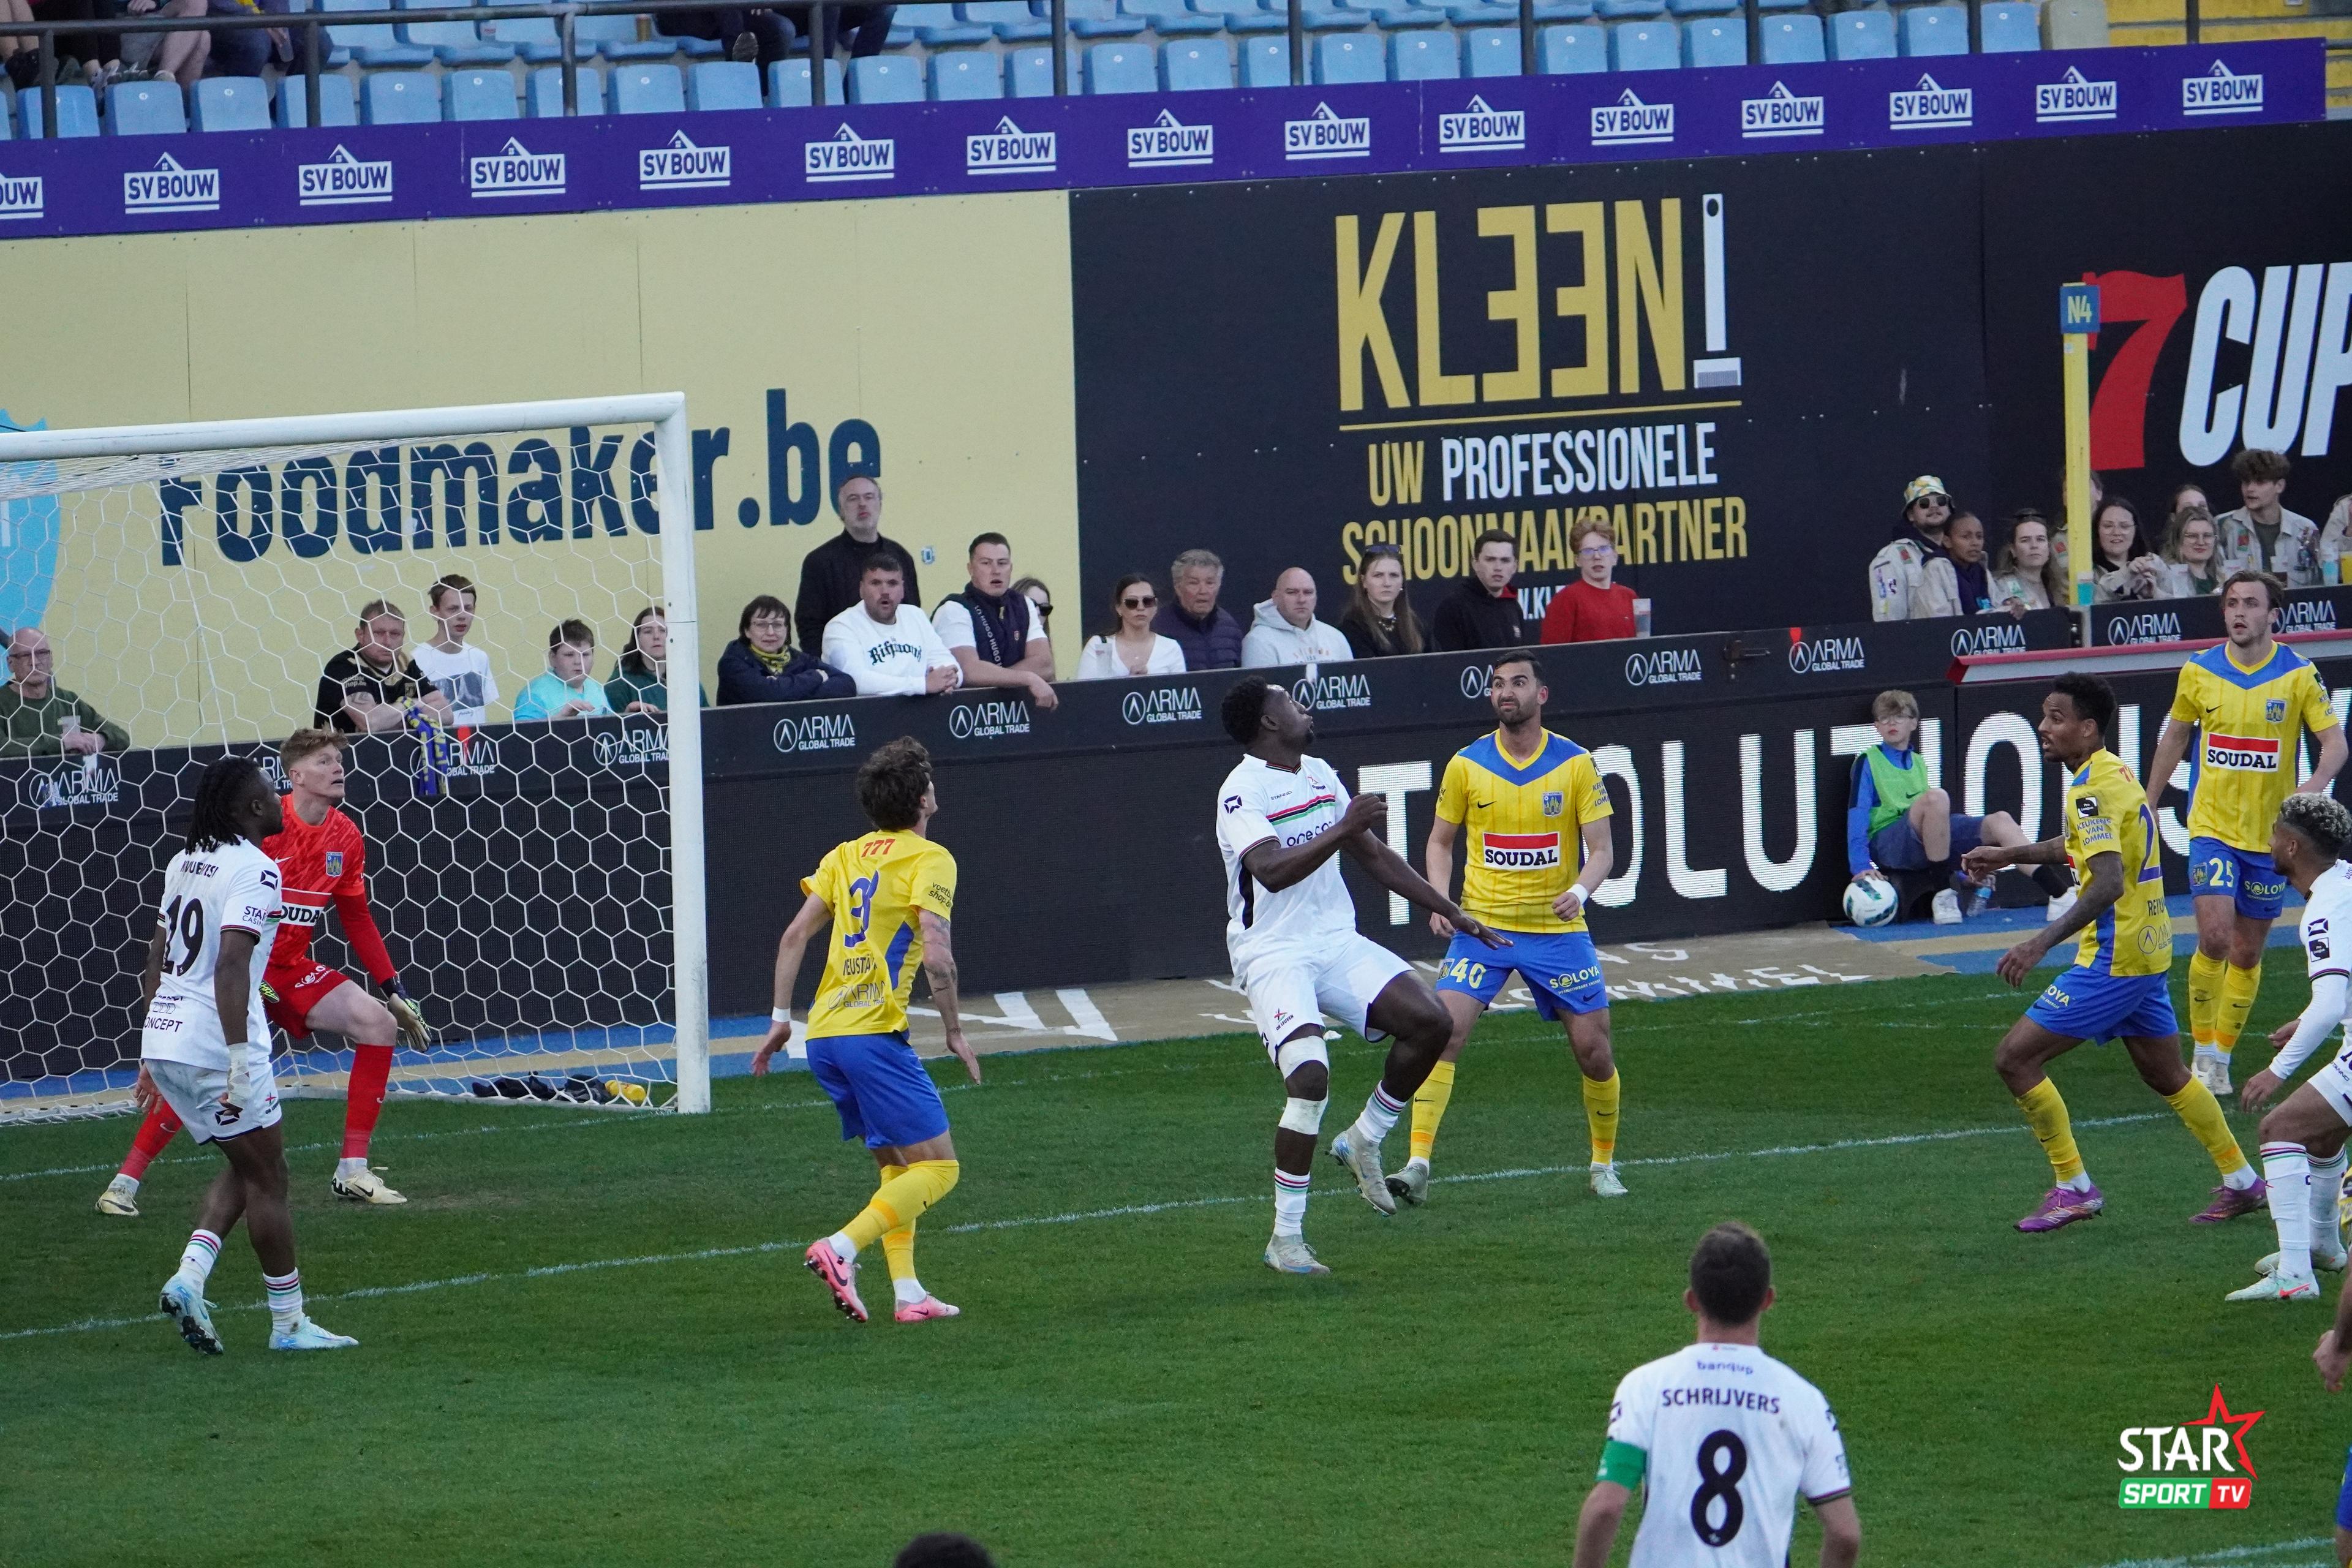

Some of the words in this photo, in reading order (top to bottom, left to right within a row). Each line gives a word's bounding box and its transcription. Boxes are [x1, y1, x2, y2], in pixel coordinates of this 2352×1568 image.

[2041, 89, 2061, 108] SV
[2065, 86, 2112, 108] BOUW
[2187, 82, 2207, 102] SV
[2212, 79, 2258, 101] BOUW
[1747, 104, 1767, 124] SV
[1772, 101, 1819, 123] BOUW
[1894, 96, 1915, 116] SV
[1920, 93, 1967, 115] BOUW
[1444, 118, 1466, 139] SV
[1469, 115, 1520, 138] BOUW
[1595, 111, 1617, 132] SV
[1620, 108, 1670, 131] BOUW
[1132, 132, 1153, 154] SV
[1158, 130, 1208, 153] BOUW
[1289, 125, 1311, 146] SV
[1316, 123, 1365, 145] BOUW
[810, 146, 833, 168] SV
[837, 144, 889, 167] BOUW
[971, 140, 994, 161] SV
[998, 137, 1050, 160] BOUW
[475, 161, 500, 184] SV
[504, 159, 560, 183] BOUW
[644, 154, 667, 176] SV
[671, 151, 725, 175] BOUW
[128, 176, 154, 200] SV
[157, 174, 214, 198] BOUW
[303, 168, 328, 191] SV
[332, 166, 388, 190] BOUW
[0, 182, 37, 205] UW
[2067, 295, 2092, 323] N4
[1368, 440, 1425, 507] UW
[1442, 423, 1717, 501] PROFESSIONELE
[1342, 497, 1747, 586] SHOONAAKARTNER
[2130, 612, 2181, 636] ARMA
[2286, 600, 2336, 625] ARMA
[981, 615, 993, 639] HUGO
[989, 638, 1001, 662] HUGO
[1974, 625, 2025, 649] ARMA
[1648, 649, 1702, 673] ARMA
[1812, 637, 1864, 662] ARMA
[1812, 662, 1841, 672] GLOBAL
[1841, 658, 1864, 669] TRADE
[1316, 674, 1371, 699] ARMA
[1648, 674, 1677, 684] GLOBAL
[1678, 671, 1702, 681] TRADE
[1146, 687, 1202, 712] ARMA
[1316, 698, 1346, 709] GLOBAL
[1346, 696, 1371, 707] TRADE
[974, 701, 1030, 726] ARMA
[1147, 712, 1177, 723] GLOBAL
[1178, 710, 1202, 720] TRADE
[798, 714, 855, 740] ARMA
[974, 725, 1004, 736] GLOBAL
[1005, 723, 1030, 734] TRADE
[798, 739, 829, 750] GLOBAL
[829, 737, 855, 748] TRADE
[619, 753, 650, 764] GLOBAL
[651, 752, 669, 762] TRAD
[2207, 749, 2276, 769] SOUDAL
[58, 768, 118, 794] ARMA
[447, 766, 468, 777] OBAL
[470, 765, 495, 775] TRADE
[91, 792, 119, 804] TRADE
[2077, 818, 2112, 830] KEUKENS
[2086, 825, 2104, 835] VAN
[861, 839, 895, 858] 777
[2083, 833, 2113, 846] LOMMEL
[1485, 849, 1558, 866] SOUDAL
[2209, 858, 2234, 888] 25
[281, 905, 321, 923] OUDA
[161, 895, 203, 977] 19
[1450, 957, 1486, 989] 40
[145, 1017, 183, 1033] ONCEPT
[1696, 1360, 1754, 1375] banqup
[1662, 1388, 1780, 1415] SCHRIJVERS
[1691, 1429, 1747, 1548] 8
